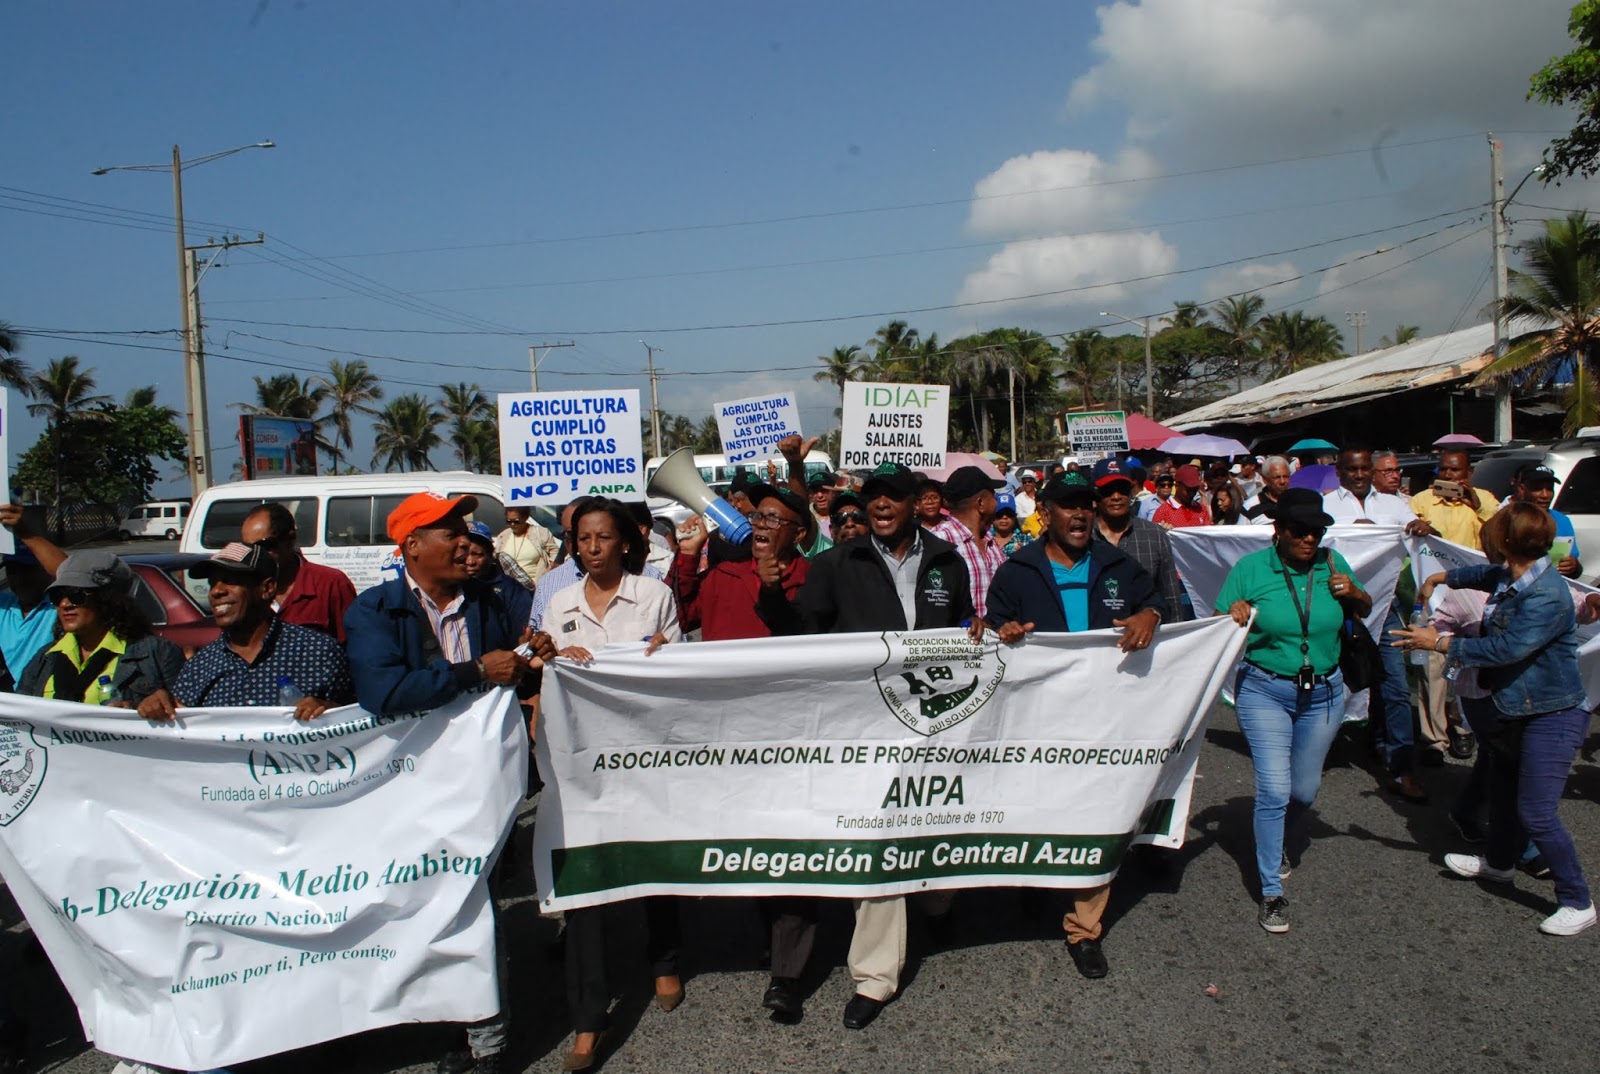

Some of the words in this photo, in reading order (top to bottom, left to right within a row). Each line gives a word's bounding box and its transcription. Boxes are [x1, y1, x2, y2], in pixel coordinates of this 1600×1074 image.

[510, 397, 628, 417] AGRICULTURA
[722, 398, 789, 417] AGRICULTURA
[531, 414, 606, 437] CUMPLIÓ
[736, 410, 778, 426] CUMPLIÓ
[868, 413, 923, 428] AJUSTES
[734, 427, 752, 438] LAS
[754, 421, 786, 435] OTRAS
[1085, 427, 1122, 436] CATEGORIAS
[525, 440, 557, 458] LAS
[561, 438, 616, 456] OTRAS
[865, 432, 923, 448] SALARIAL
[730, 450, 756, 463] NO
[845, 451, 869, 465] POR
[873, 452, 942, 467] CATEGORIA
[508, 457, 636, 478] INSTITUCIONES
[511, 482, 559, 501] NO
[588, 484, 637, 495] ANPA
[902, 638, 949, 646] ASOCIACION
[921, 647, 984, 655] PROFESIONALES
[964, 661, 983, 669] DOM.
[883, 686, 902, 711] OMNIA
[928, 697, 983, 734] QUISQUEYA
[248, 746, 356, 784] (ANPA)
[592, 745, 726, 772] ASOCIACIÓN
[730, 746, 835, 766] NACIONAL
[840, 746, 868, 764] DE
[873, 746, 1026, 764] PROFESIONALES
[201, 786, 255, 802] Fundada
[259, 785, 271, 800] el
[274, 783, 282, 799] 4
[286, 781, 303, 798] de
[307, 778, 359, 797] Octubre
[386, 757, 415, 776] 1970
[12, 783, 36, 811] TIERRA
[881, 775, 964, 809] ANPA
[836, 815, 884, 829] Fundada
[886, 813, 895, 827] el
[896, 814, 908, 827] 04
[911, 813, 922, 827] de
[925, 811, 960, 825] Octubre
[964, 811, 976, 824] de
[980, 810, 1005, 824] 1970
[701, 847, 872, 877] Delegación
[881, 846, 925, 871] Sur
[931, 841, 1029, 865] Central
[1033, 842, 1102, 865] Azua
[272, 864, 369, 900] Medio
[185, 910, 257, 928] Distrito
[264, 906, 348, 927] Nacional
[243, 963, 273, 985] por
[277, 955, 293, 973] ti,
[299, 948, 337, 967] Pero
[342, 944, 397, 962] contigo
